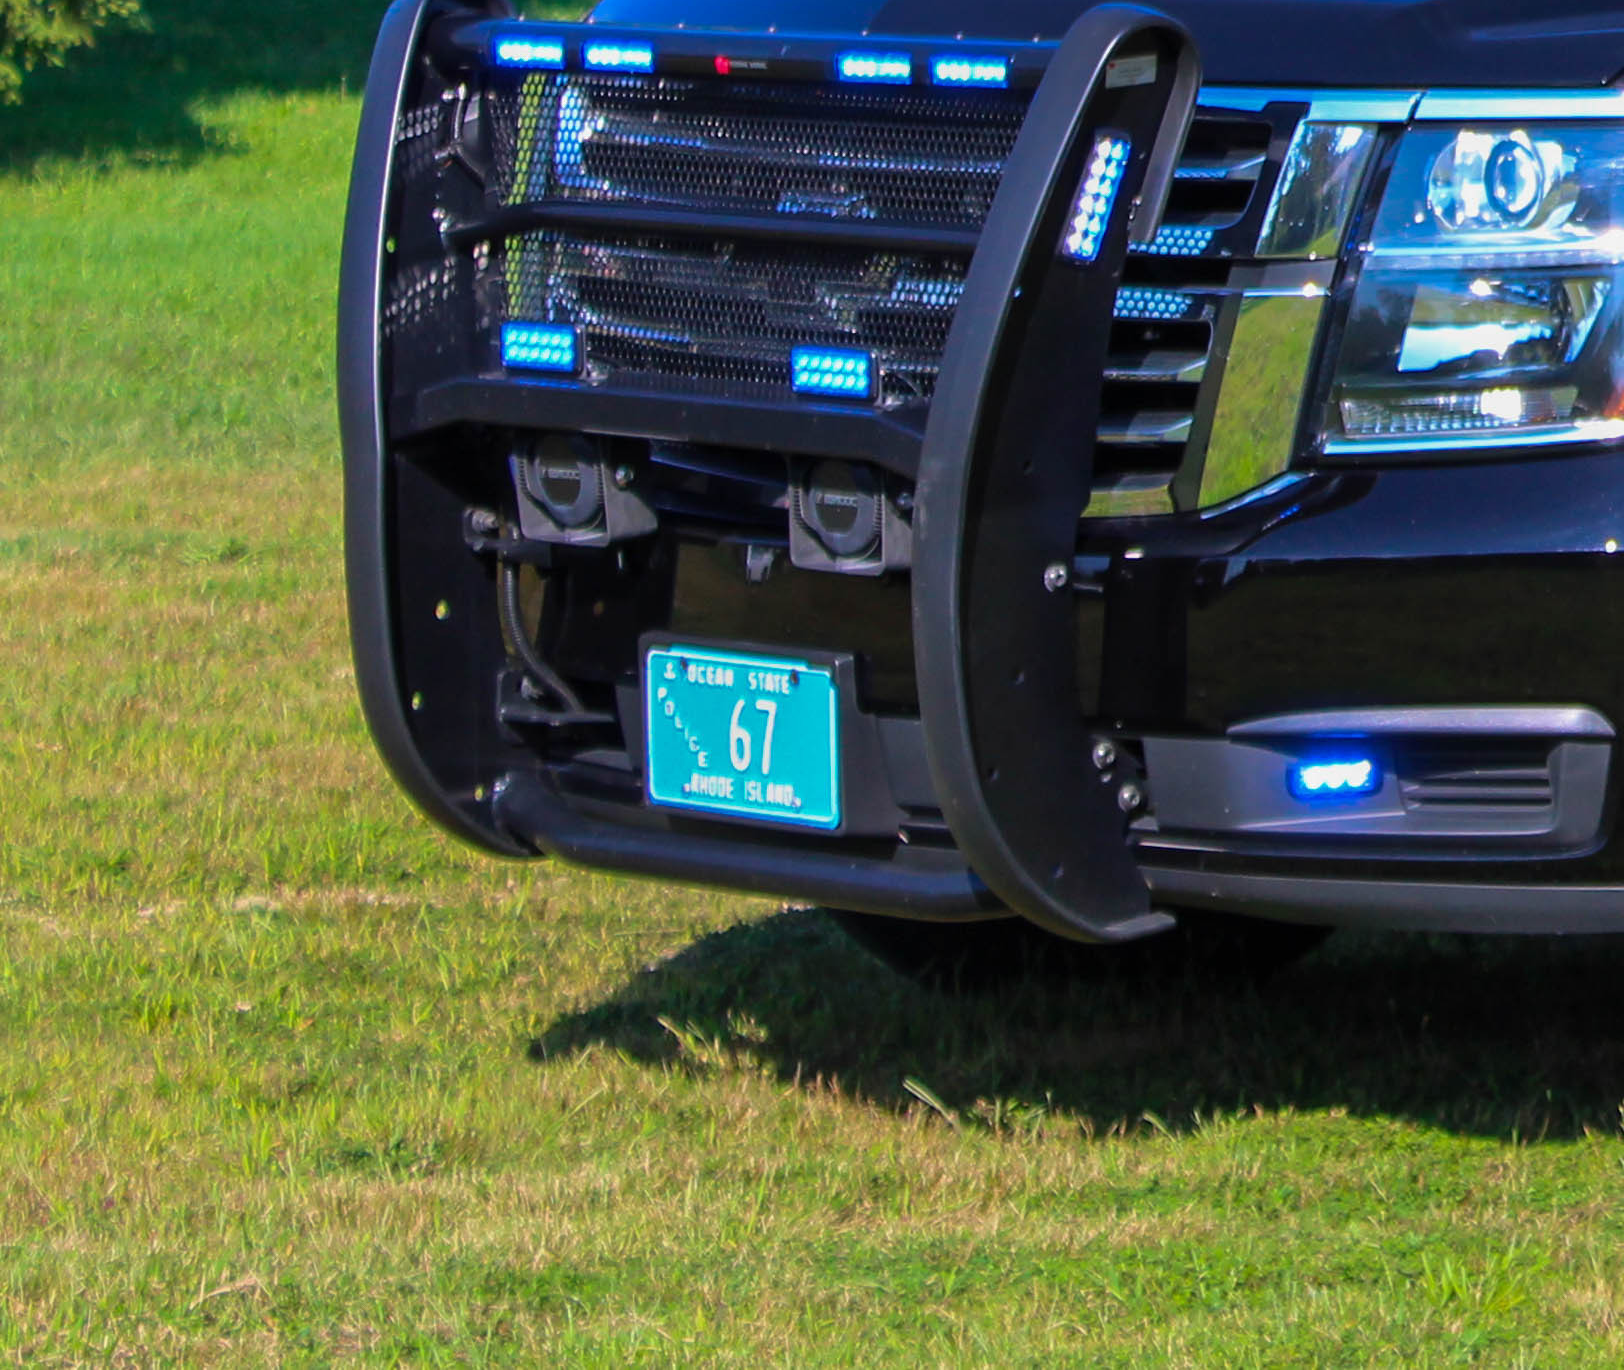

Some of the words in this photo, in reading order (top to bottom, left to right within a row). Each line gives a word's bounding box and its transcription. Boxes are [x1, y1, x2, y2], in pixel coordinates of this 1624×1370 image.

[687, 664, 734, 688] OCEAN
[748, 672, 790, 695] STATE
[657, 686, 708, 767] POLICE
[730, 699, 777, 775] 67
[690, 773, 735, 799] RHODE
[745, 781, 794, 806] ISLAND
